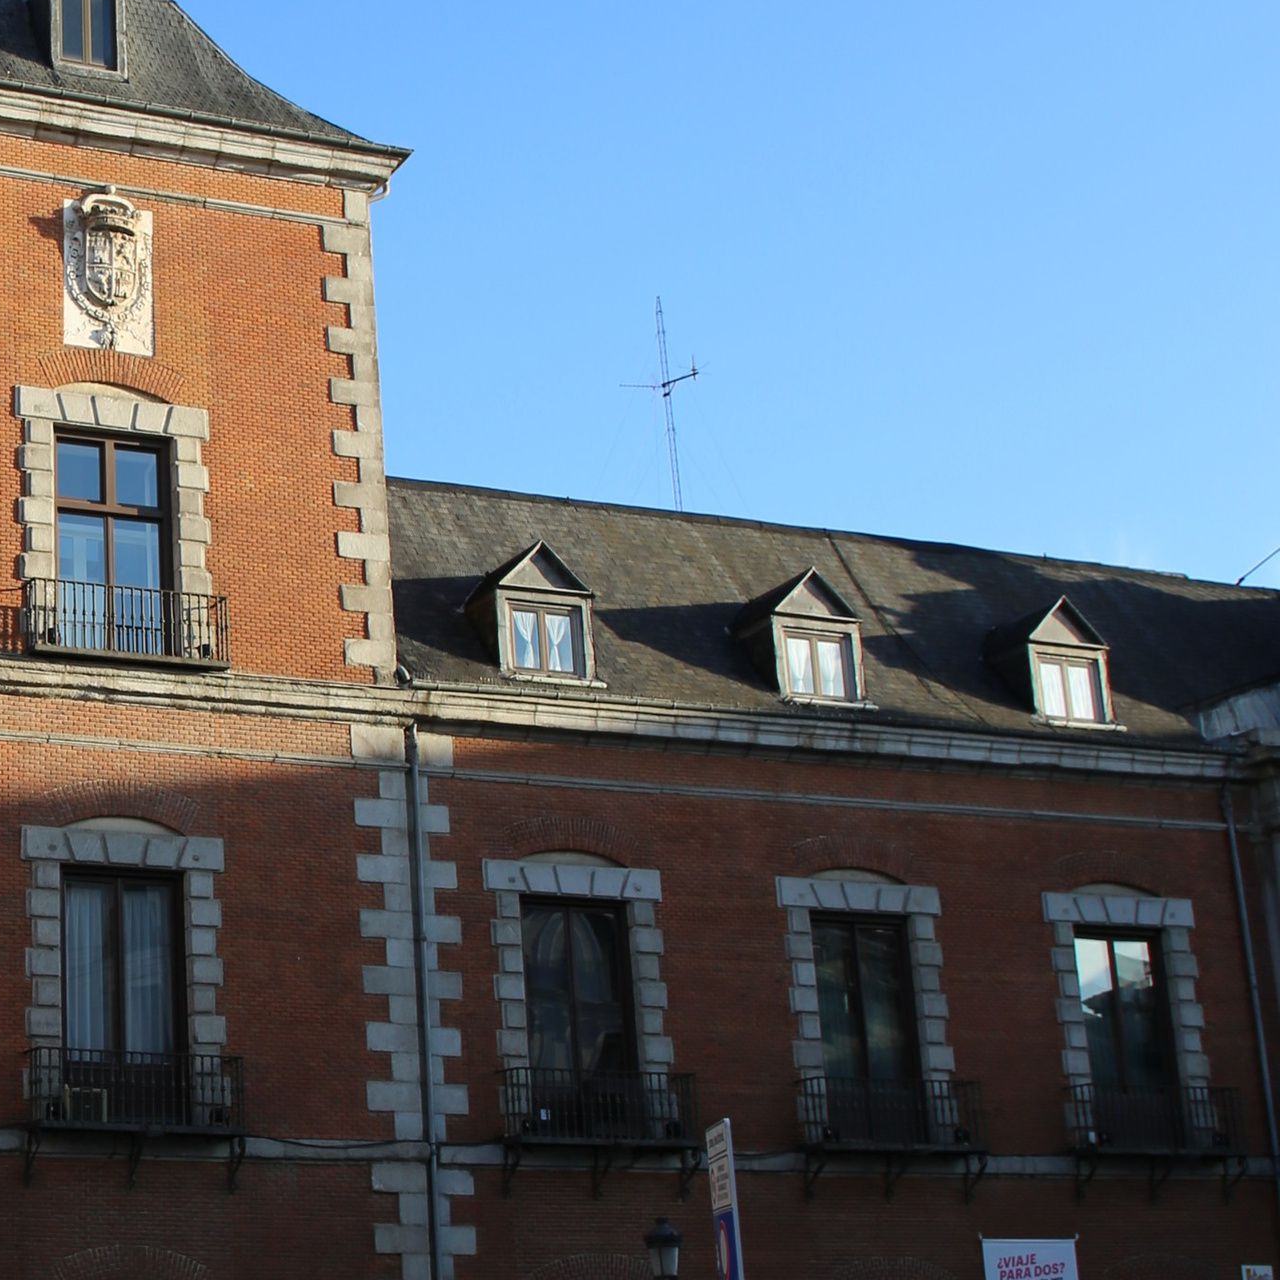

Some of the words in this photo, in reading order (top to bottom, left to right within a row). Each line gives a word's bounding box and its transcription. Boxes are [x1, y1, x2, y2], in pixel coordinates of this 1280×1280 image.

[997, 1253, 1036, 1269] ¿VIAJE
[1000, 1267, 1031, 1280] PARA
[1034, 1262, 1065, 1277] DOS?
